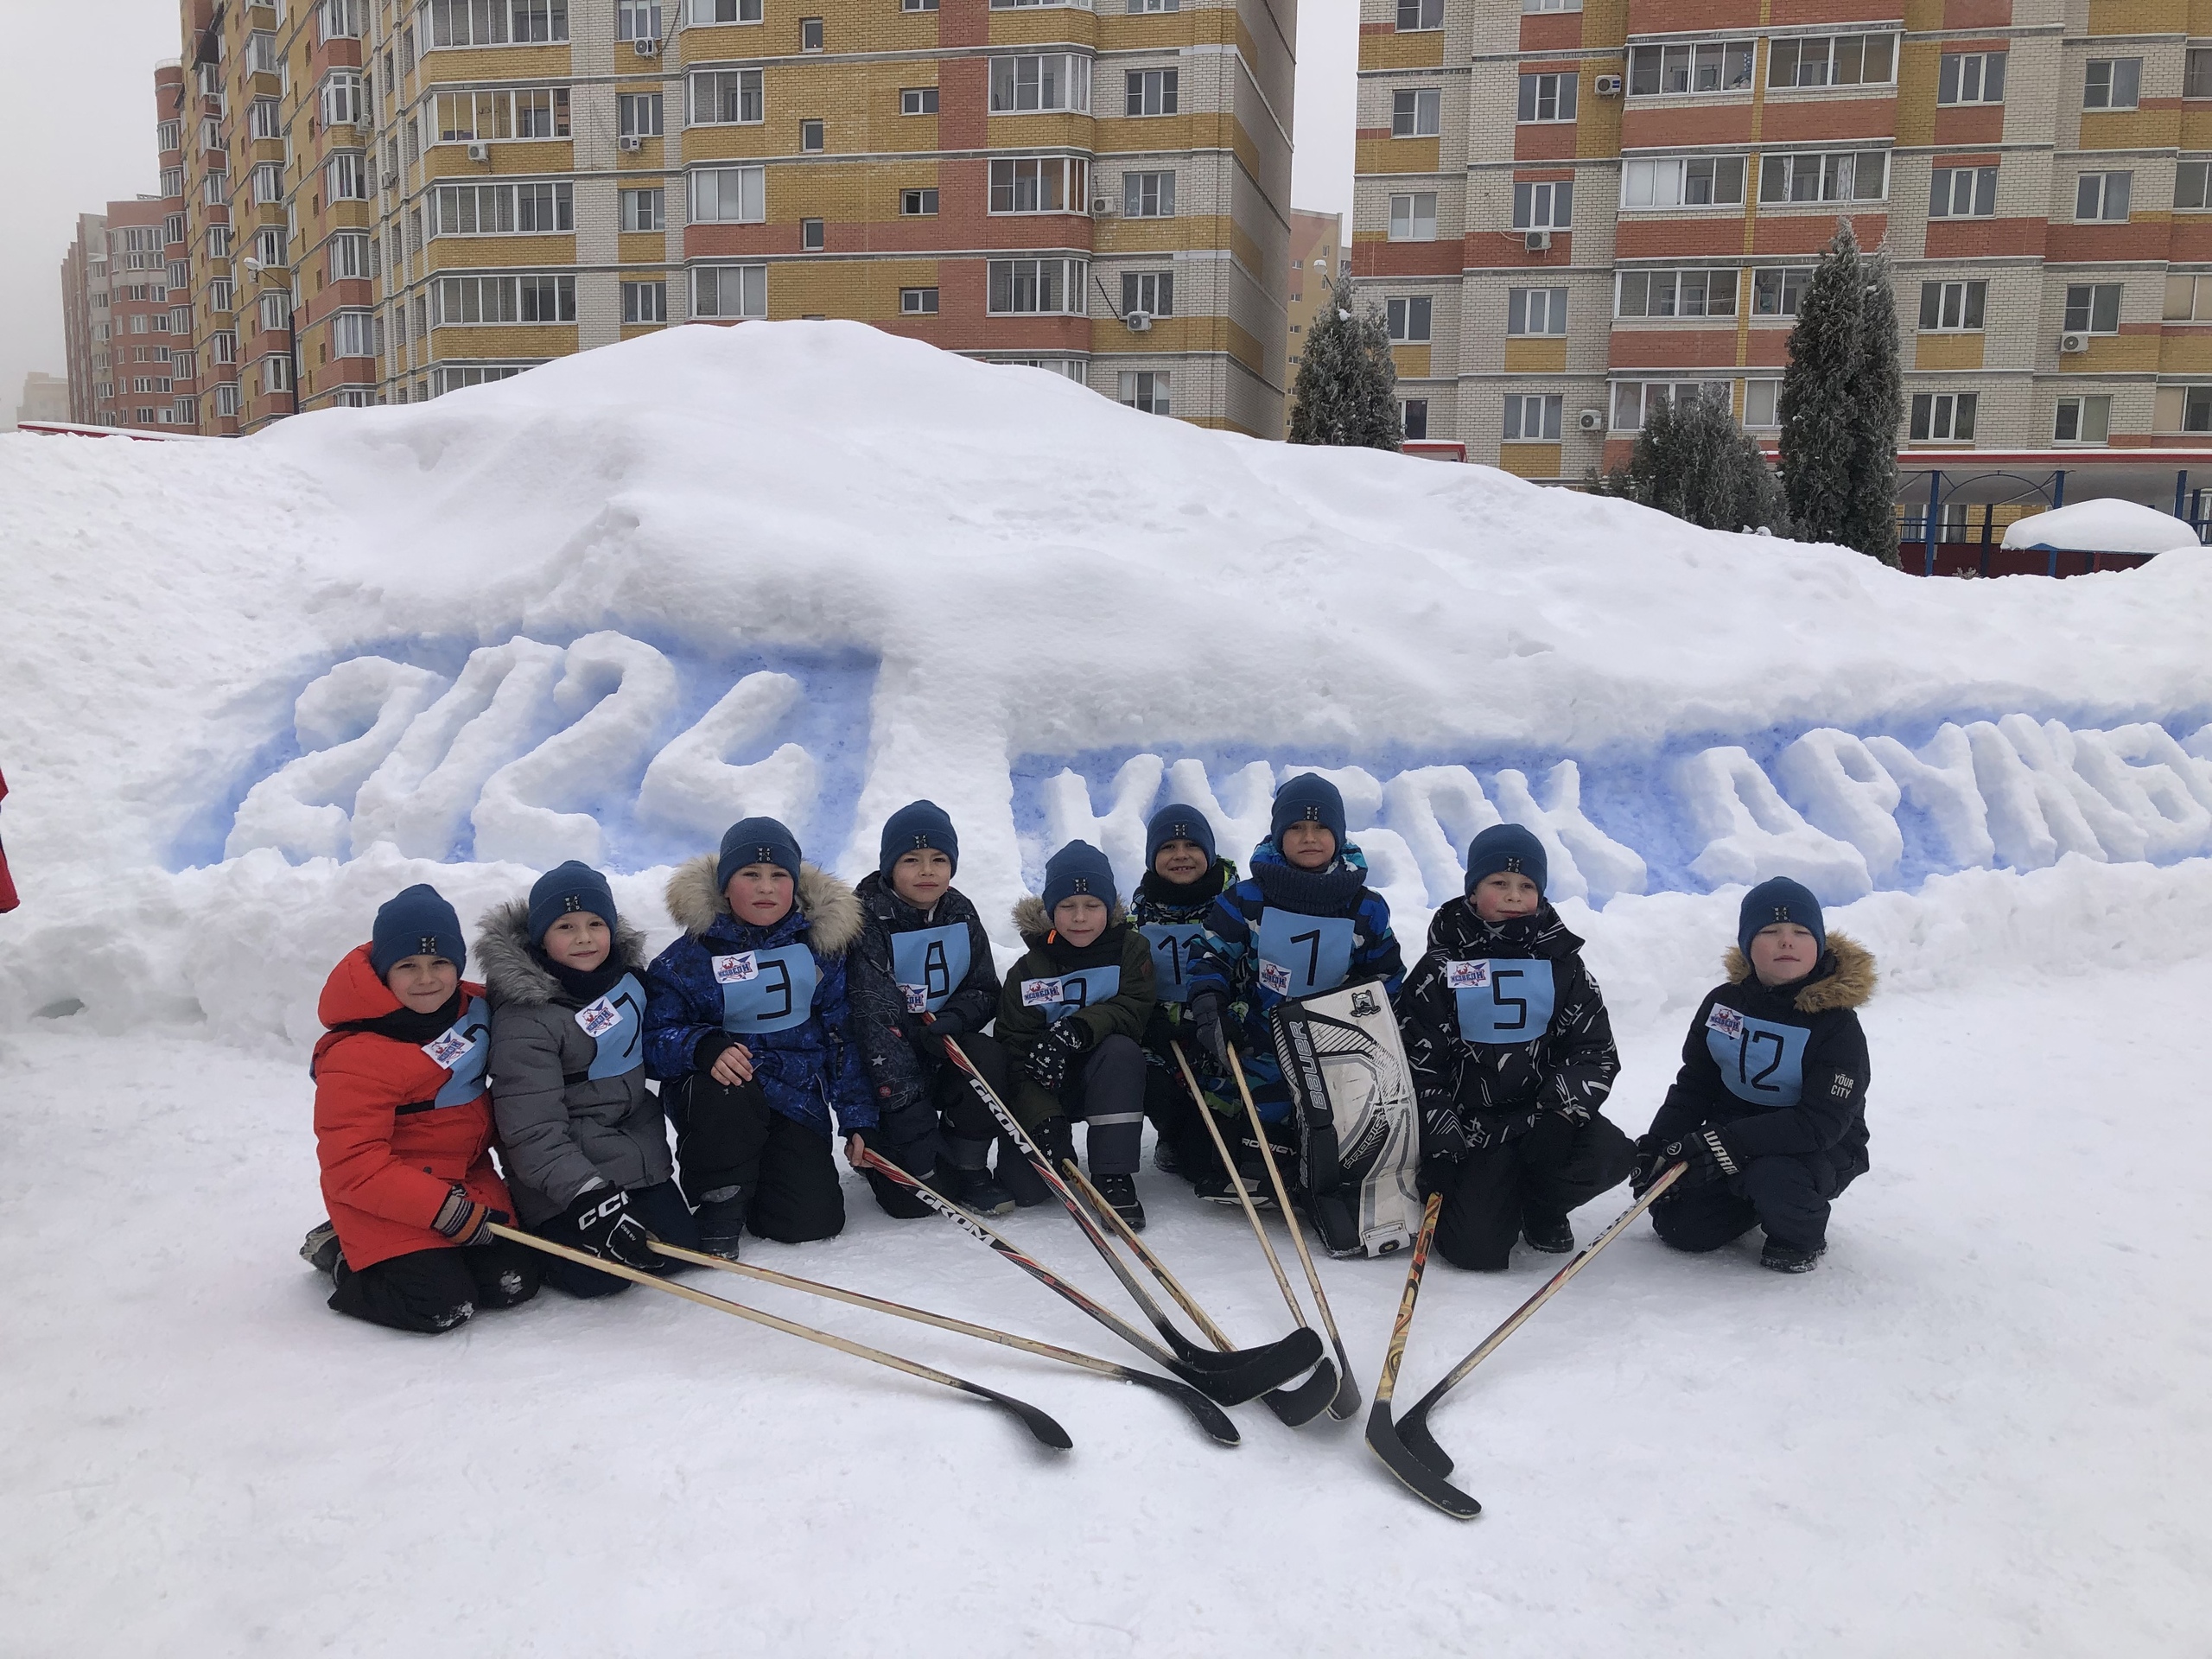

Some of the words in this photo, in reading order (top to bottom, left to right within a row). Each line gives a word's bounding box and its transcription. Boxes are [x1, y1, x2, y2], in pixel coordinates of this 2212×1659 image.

[756, 959, 791, 1020] 3
[924, 939, 950, 999] 8
[1491, 969, 1527, 1030] 5
[1731, 1027, 1783, 1092] 12
[969, 1078, 1033, 1154] GROM
[1830, 1084, 1852, 1099] CITY
[915, 1189, 996, 1246] GROM
